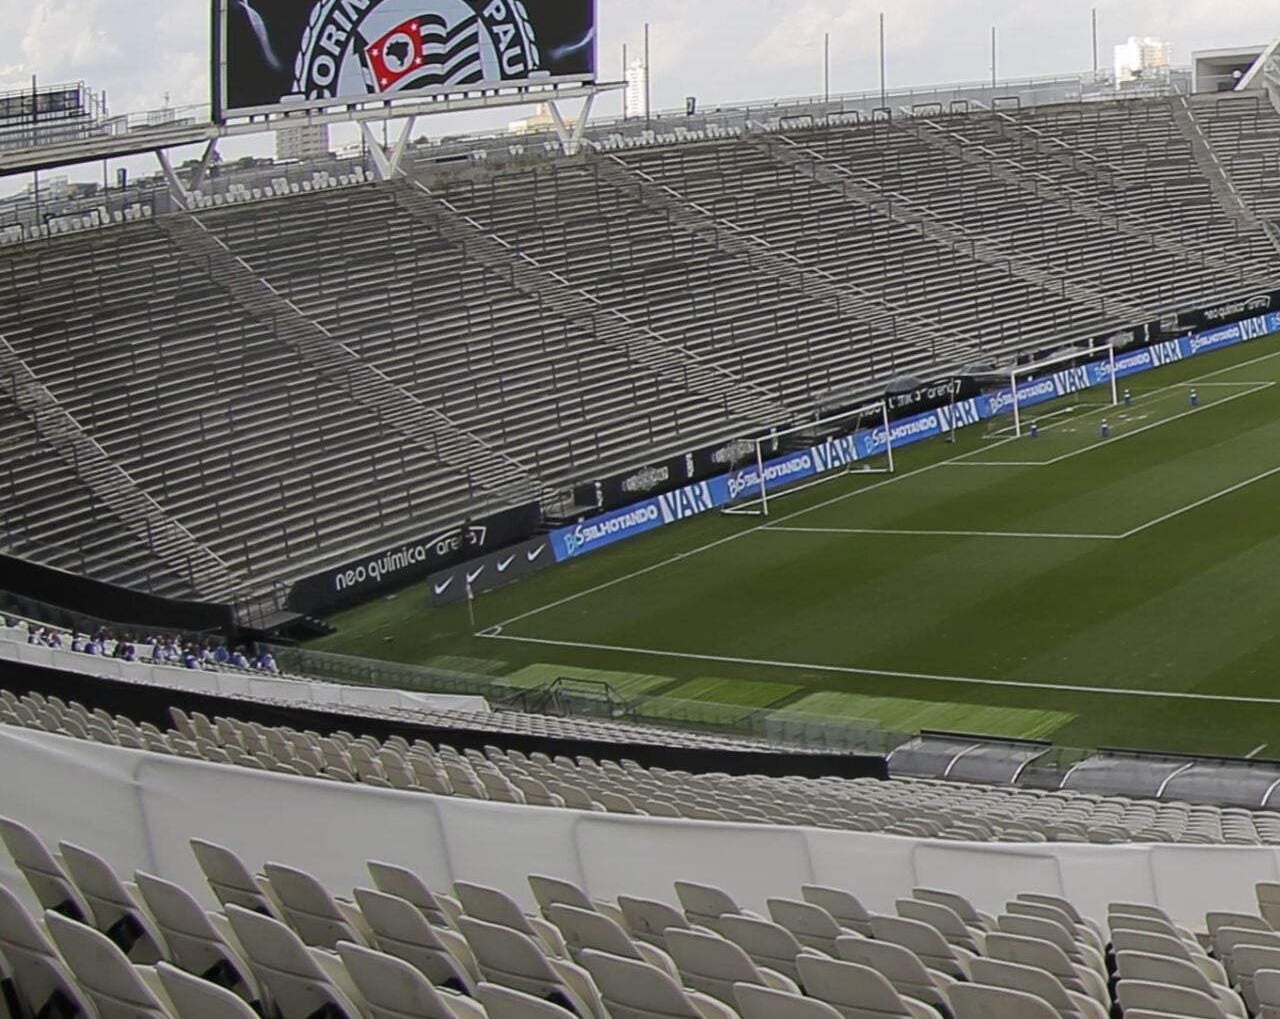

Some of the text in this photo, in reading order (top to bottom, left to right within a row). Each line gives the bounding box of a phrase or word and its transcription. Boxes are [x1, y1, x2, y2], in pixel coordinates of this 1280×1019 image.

[1240, 315, 1267, 340] VAR
[1151, 339, 1182, 367] VAR
[1054, 366, 1089, 396] VAR
[938, 399, 979, 431] VAR
[812, 436, 856, 472] VAR
[660, 480, 712, 523] VAR
[336, 532, 477, 590] neo química area
